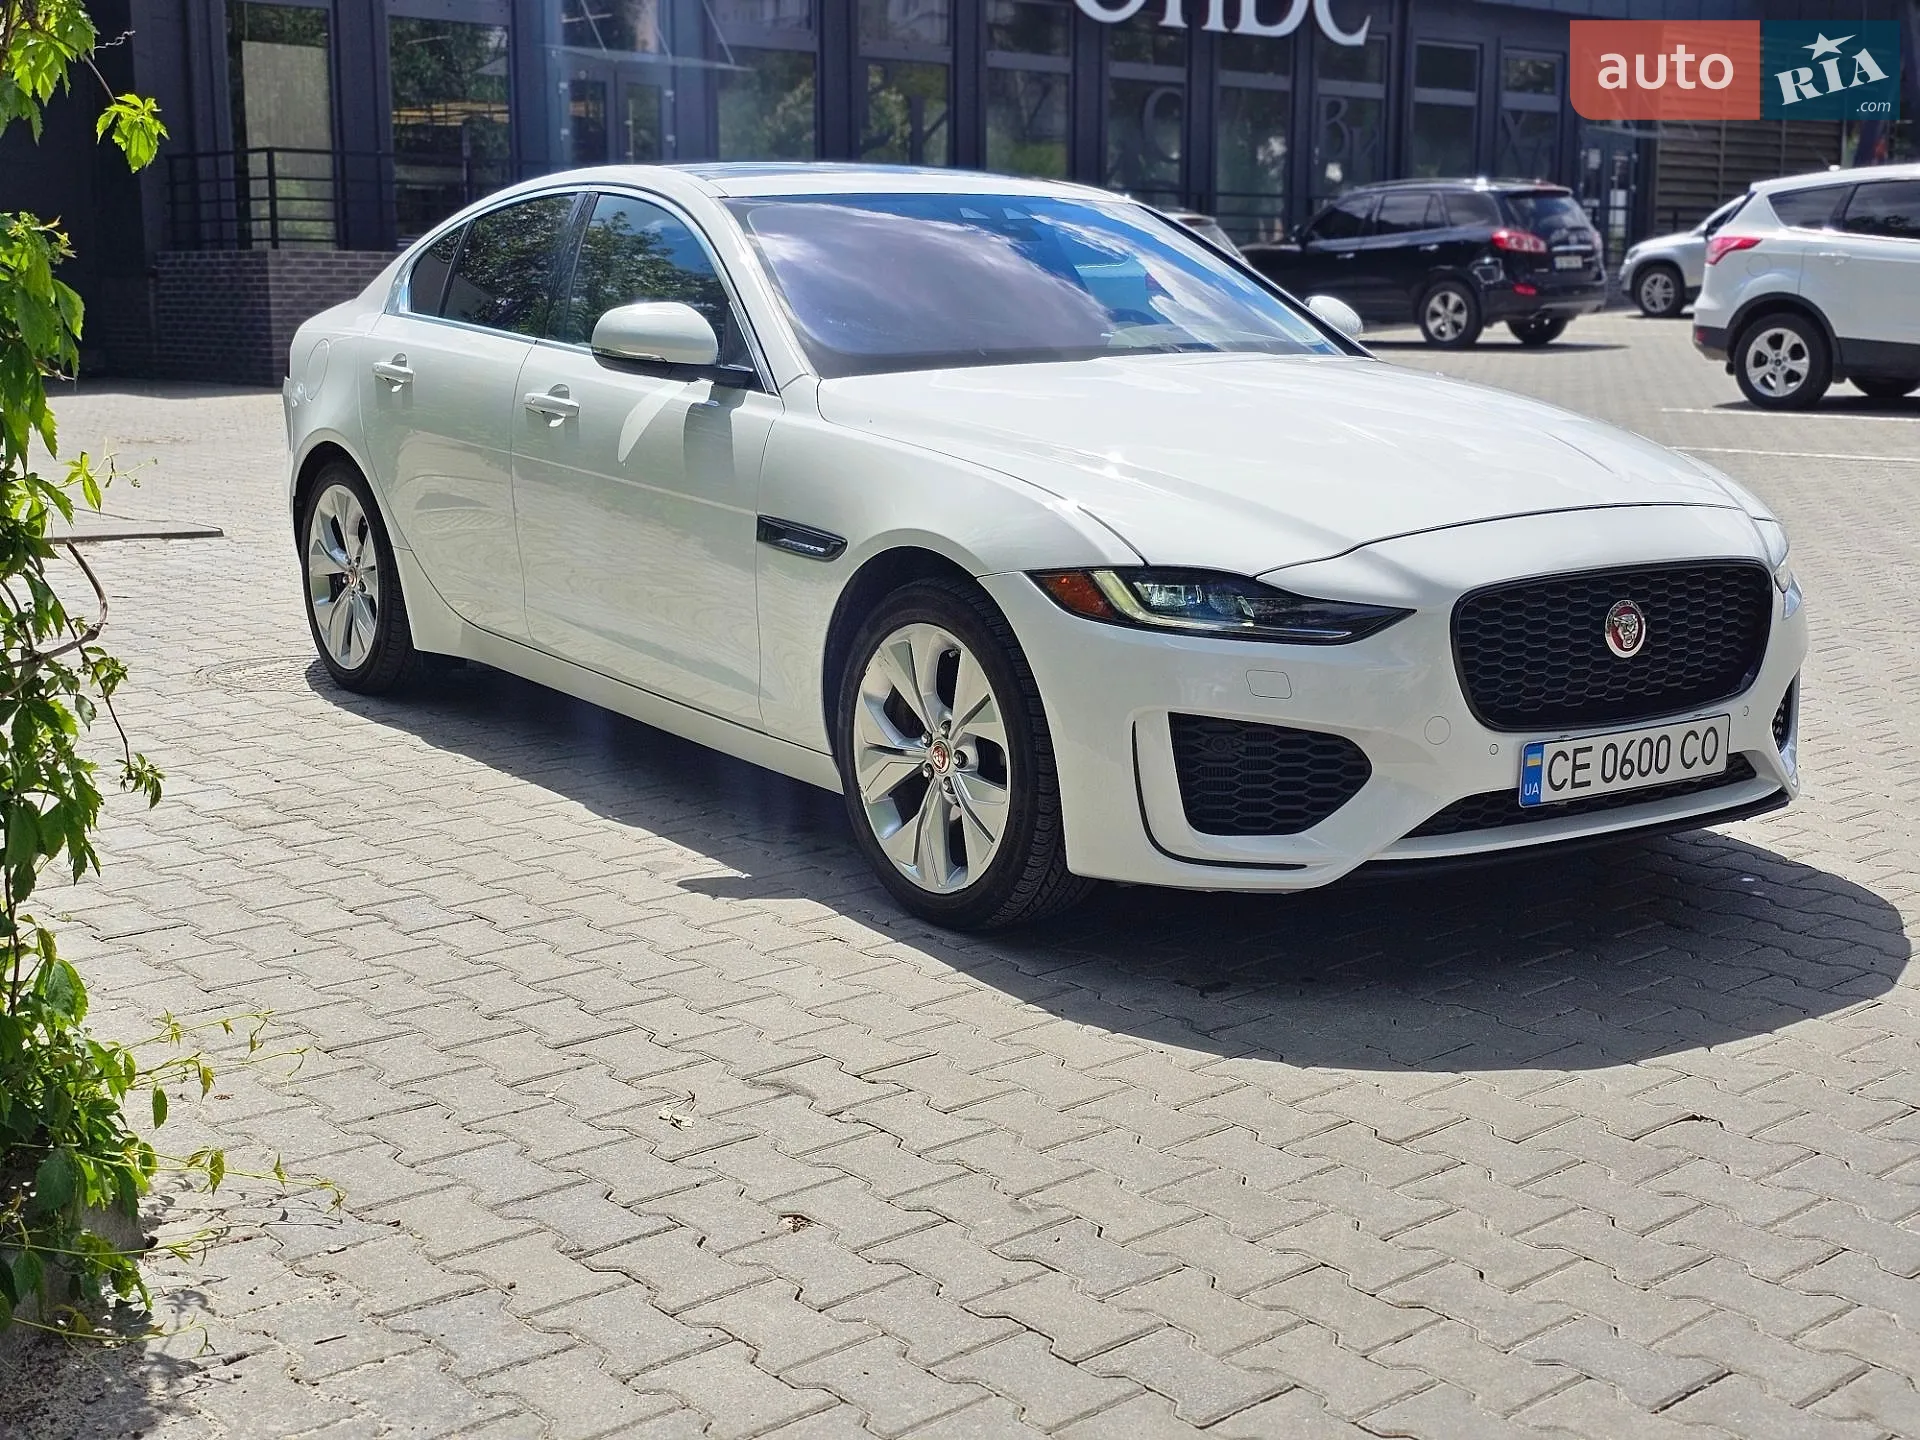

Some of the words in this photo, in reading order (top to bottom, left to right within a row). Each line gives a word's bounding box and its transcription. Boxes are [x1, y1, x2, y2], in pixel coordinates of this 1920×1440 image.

[1547, 746, 1593, 792] CE
[1600, 734, 1671, 784] 0600
[1680, 726, 1719, 770] CO
[1524, 782, 1540, 797] UA
